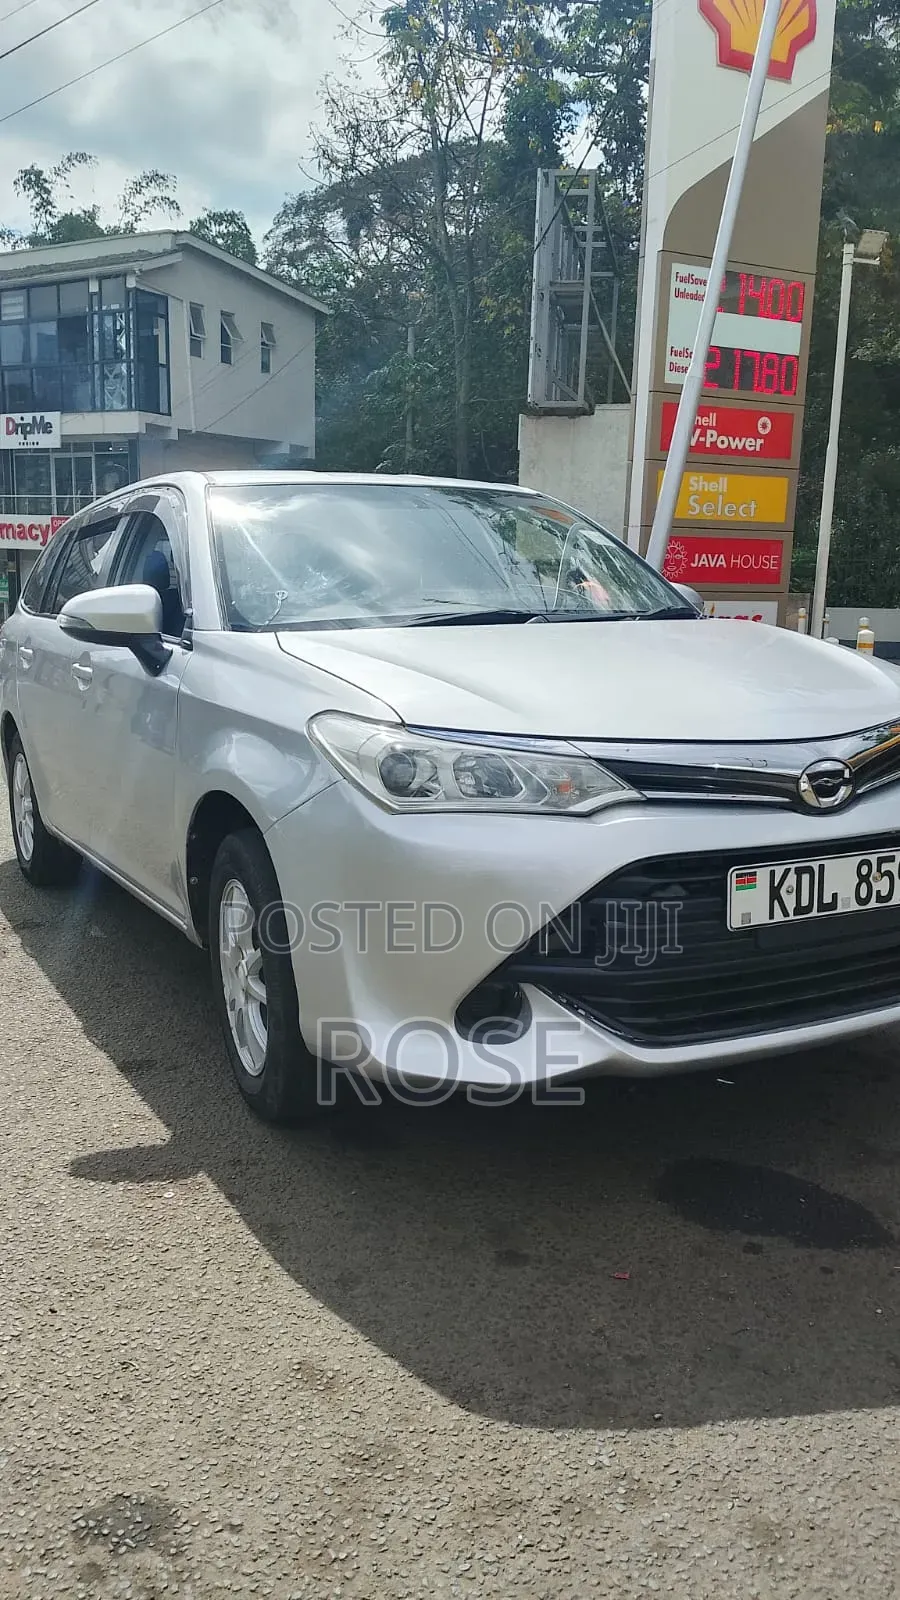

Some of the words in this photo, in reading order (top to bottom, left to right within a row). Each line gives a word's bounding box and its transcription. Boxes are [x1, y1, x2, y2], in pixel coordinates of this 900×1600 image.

[6, 415, 53, 441] DripMe
[694, 412, 717, 427] hell
[689, 475, 728, 492] Shell
[687, 494, 757, 518] Select
[690, 553, 727, 569] JAVA
[730, 554, 780, 570] HOUSE
[768, 863, 838, 921] KDL
[854, 854, 900, 907] 85
